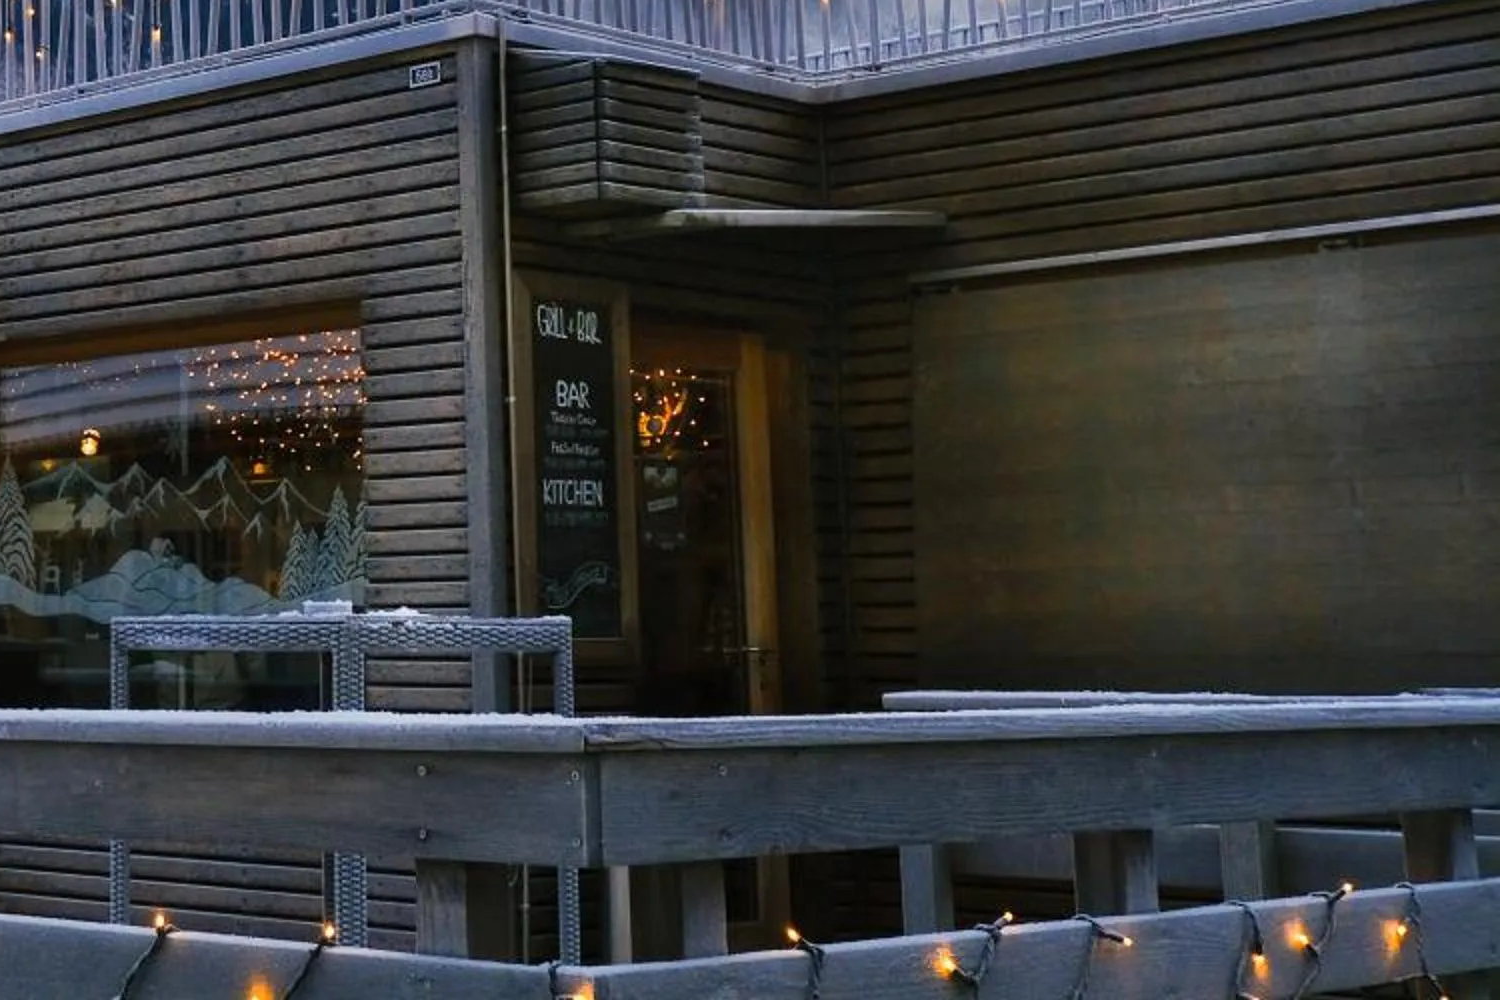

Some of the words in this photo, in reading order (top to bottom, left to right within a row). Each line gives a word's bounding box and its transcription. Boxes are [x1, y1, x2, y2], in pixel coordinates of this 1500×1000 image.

[577, 310, 603, 345] BAR
[555, 379, 592, 409] BAR
[543, 478, 603, 508] KITCHEN
